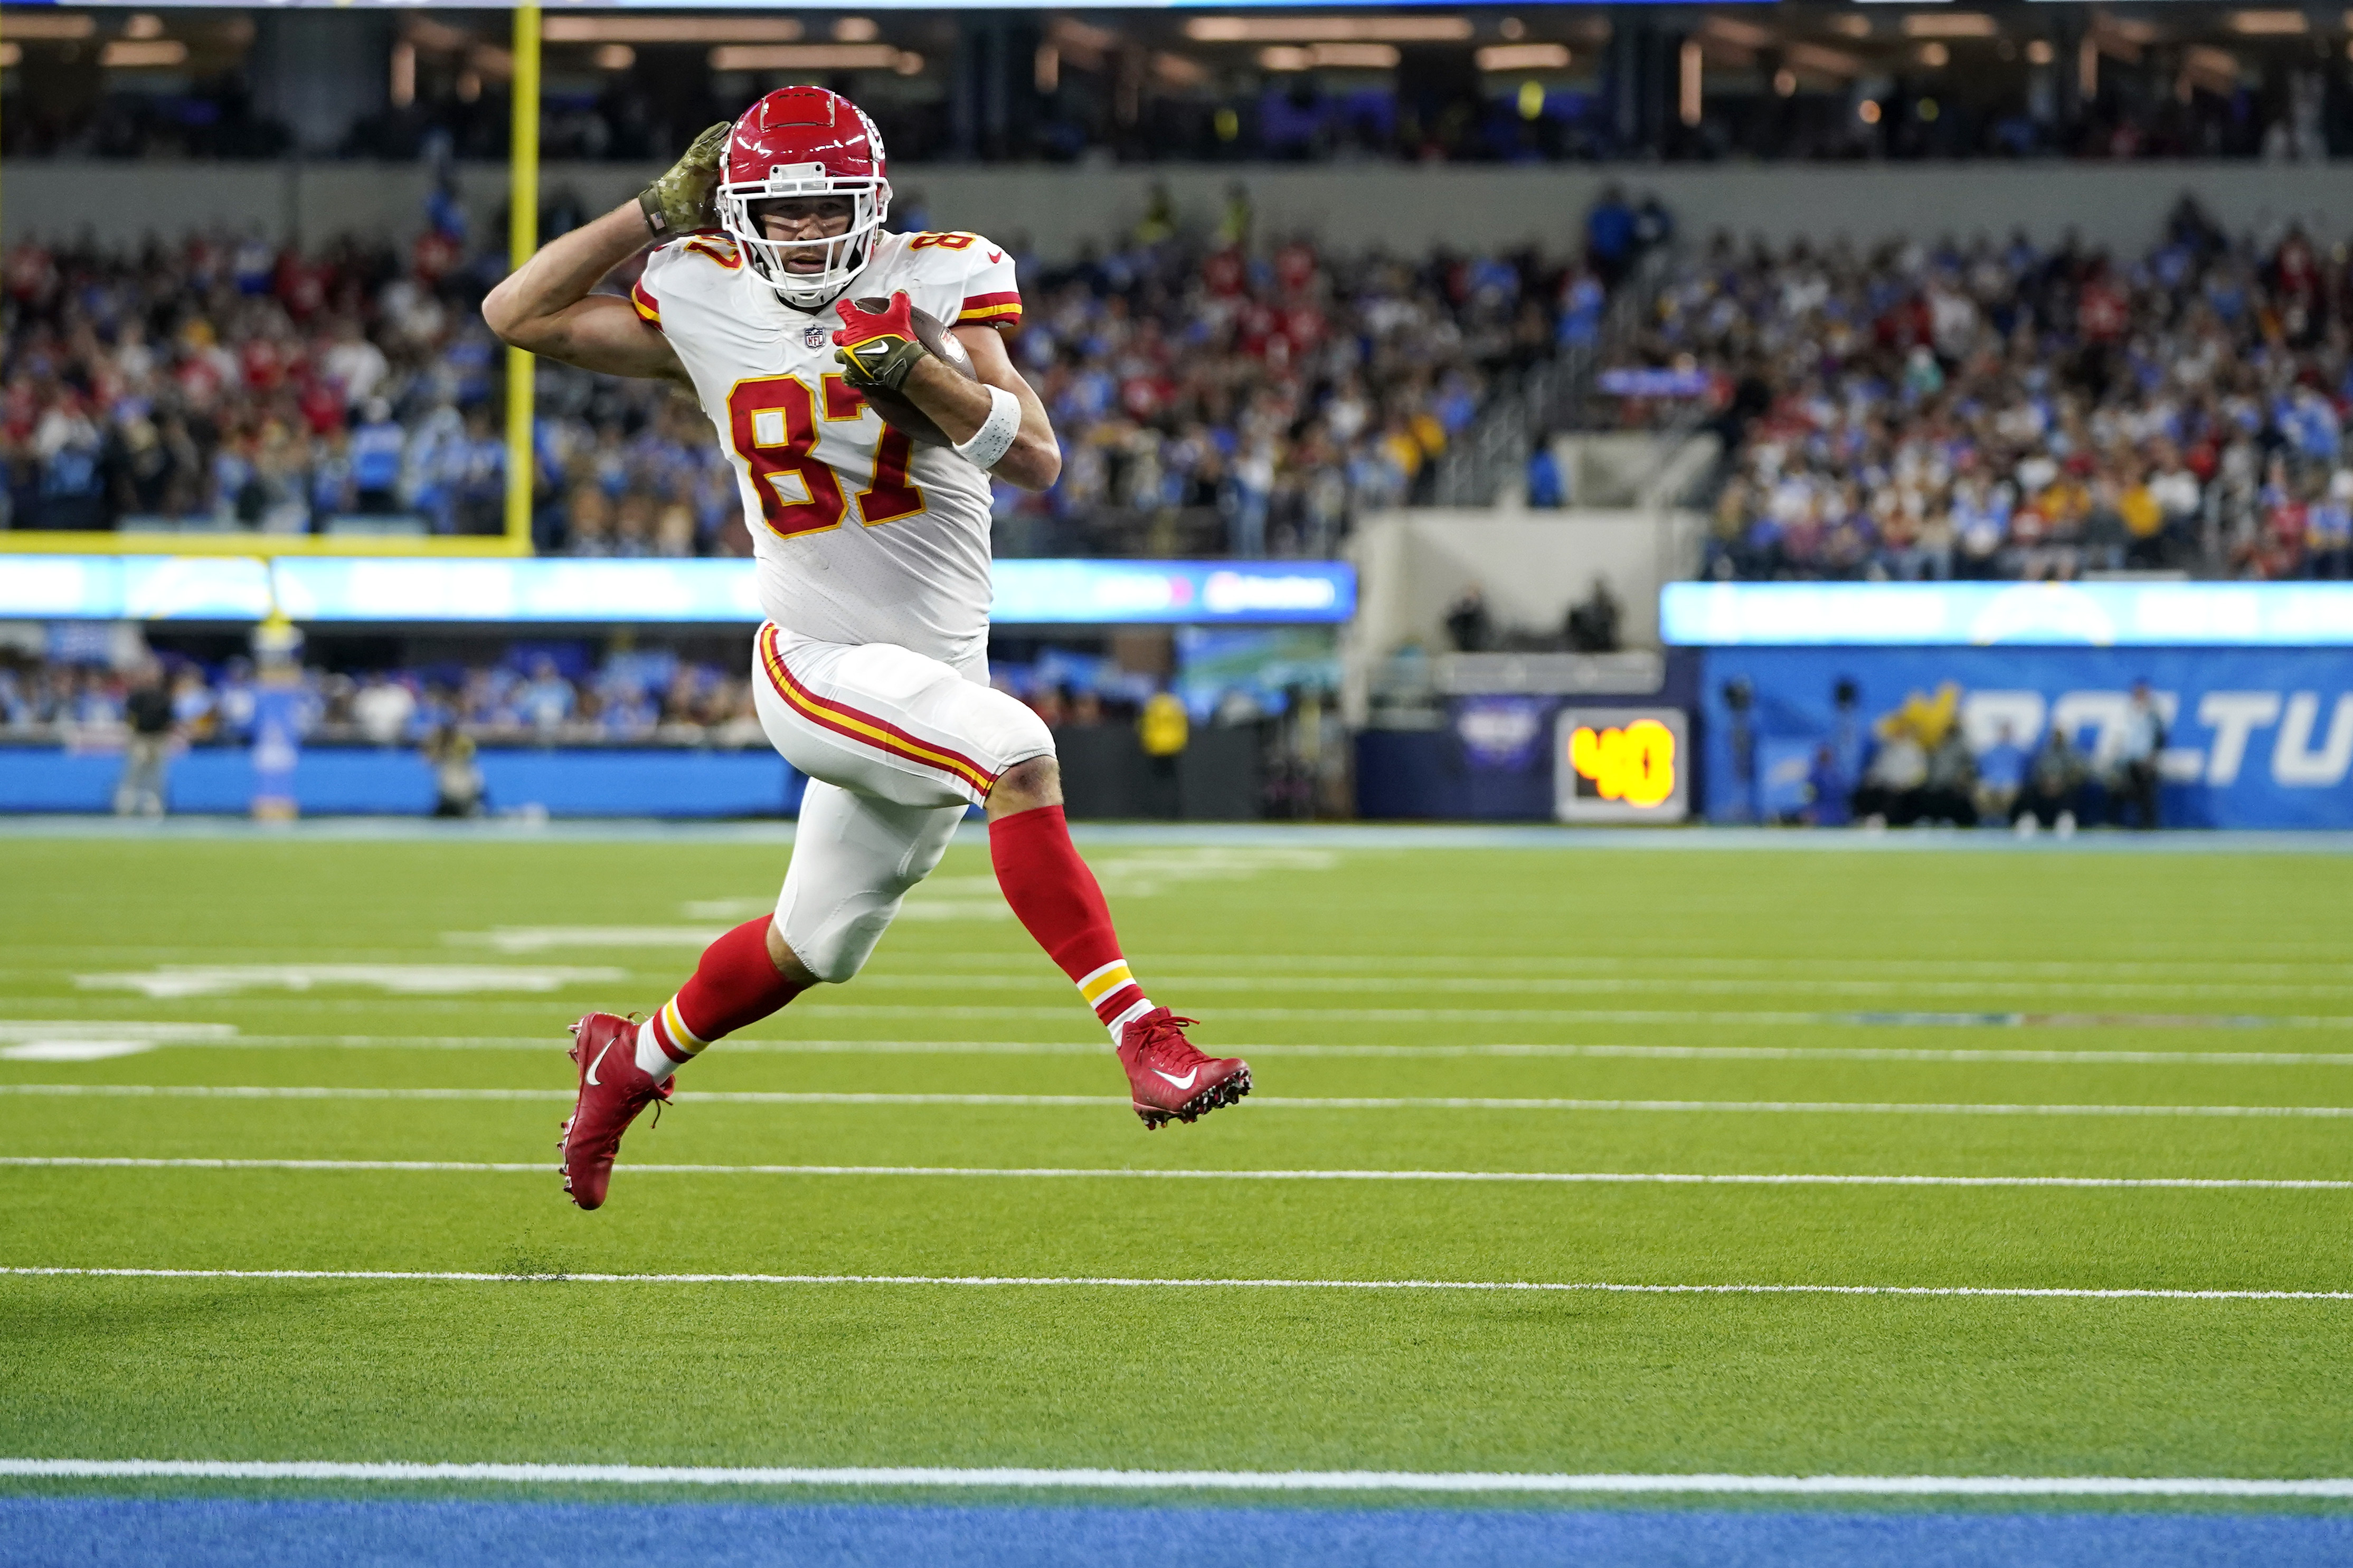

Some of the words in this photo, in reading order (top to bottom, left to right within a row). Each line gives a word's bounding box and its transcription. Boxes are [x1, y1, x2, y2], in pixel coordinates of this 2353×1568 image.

[908, 231, 977, 252] 8
[808, 335, 823, 346] NFL
[726, 373, 927, 539] 87
[1568, 719, 1675, 808] 40
